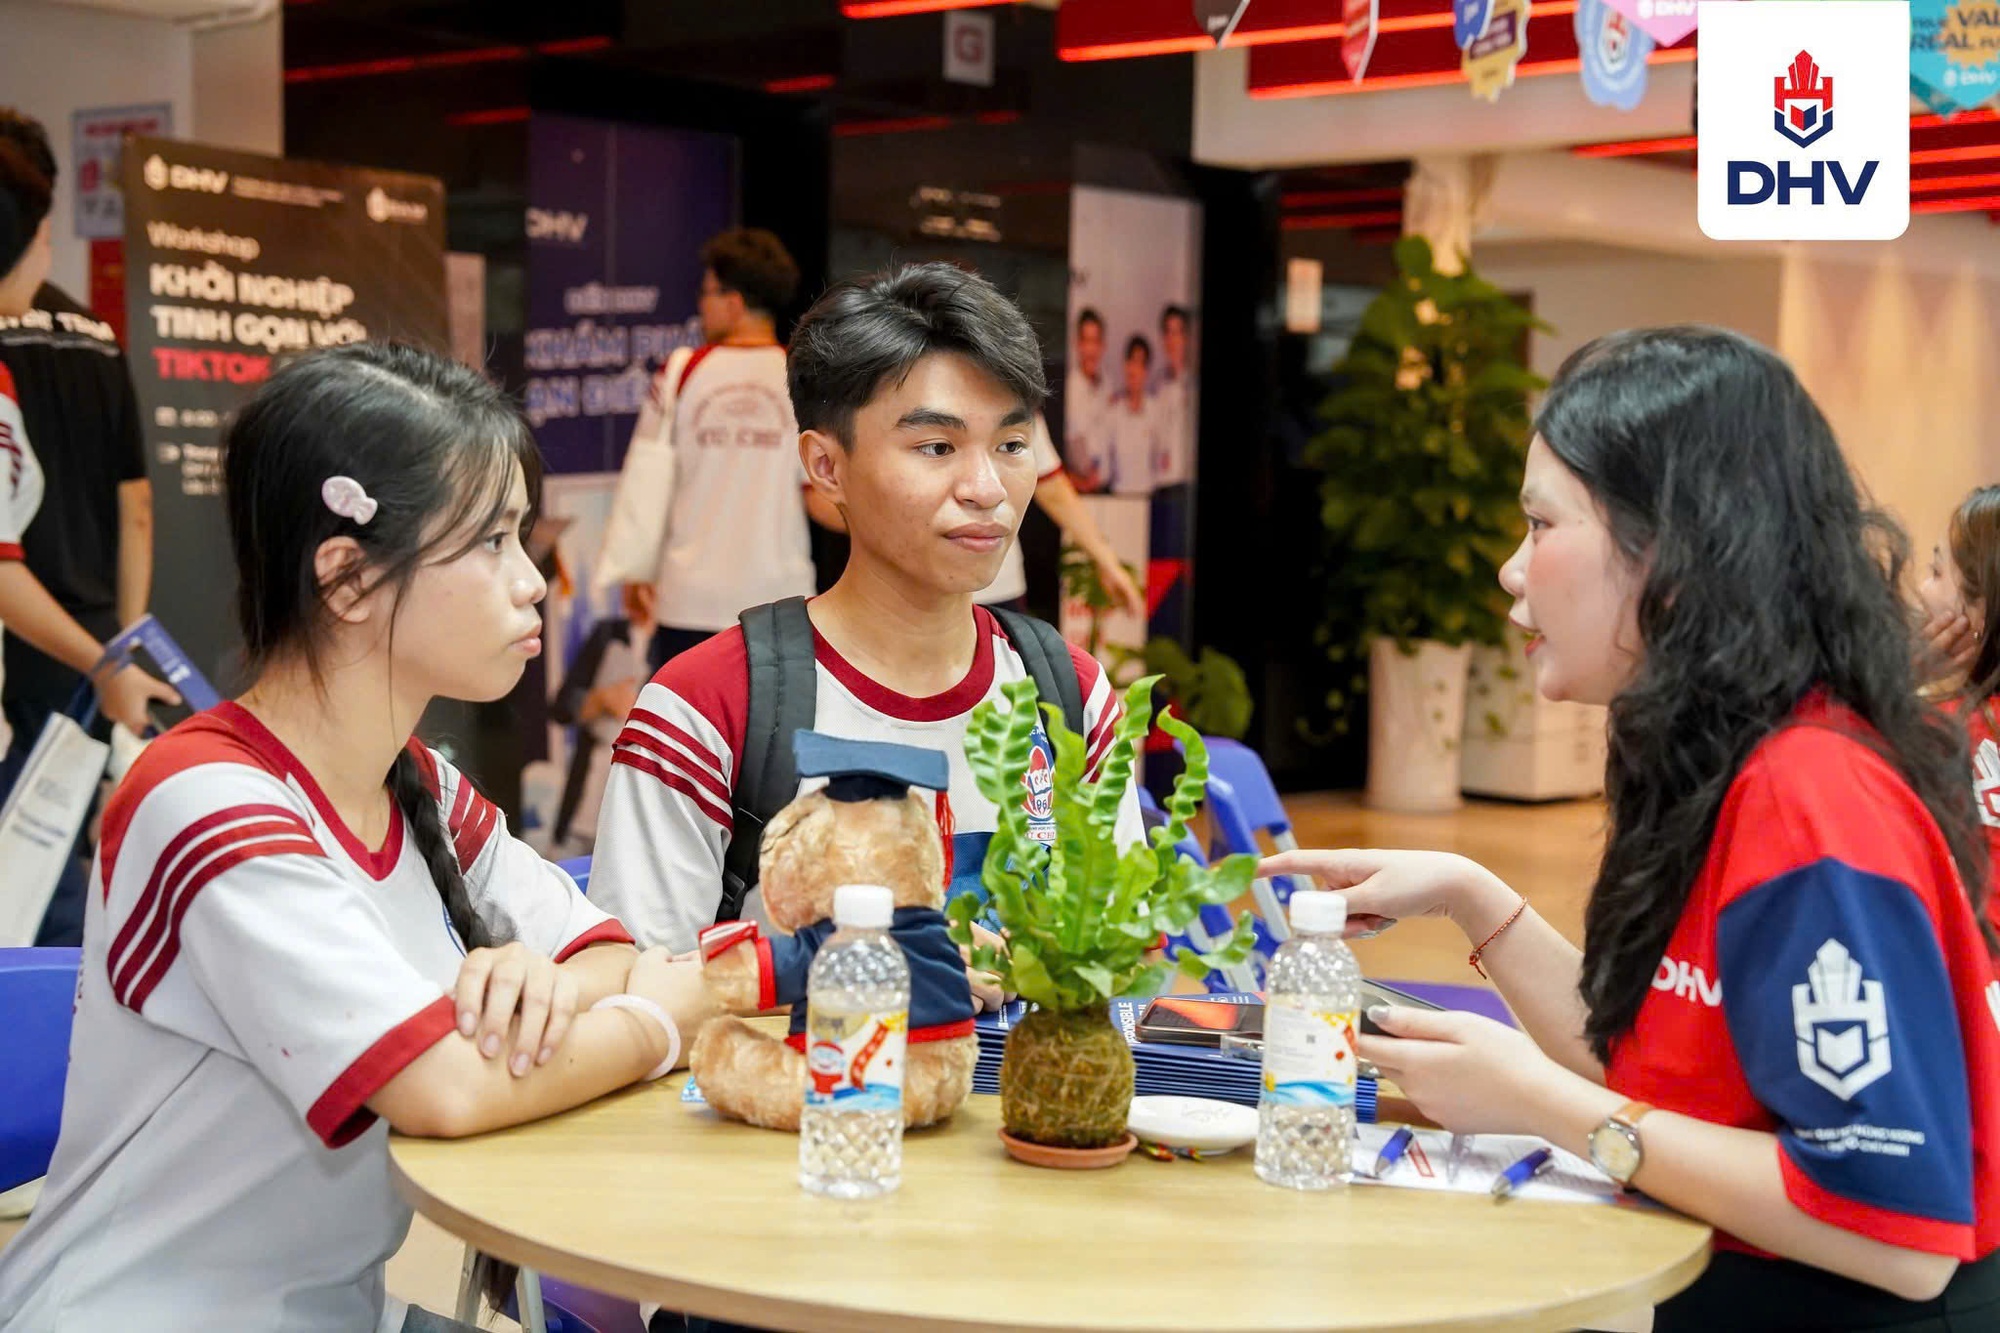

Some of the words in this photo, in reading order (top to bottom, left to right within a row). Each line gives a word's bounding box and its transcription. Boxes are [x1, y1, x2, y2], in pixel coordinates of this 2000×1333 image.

[170, 163, 229, 194] DHV
[147, 219, 261, 264] Workshop
[237, 272, 356, 320] NGHIỆP
[150, 303, 232, 344] TINH
[233, 312, 310, 355] GỌN
[153, 345, 272, 385] TIKTOK
[1650, 955, 1723, 1007] DHV
